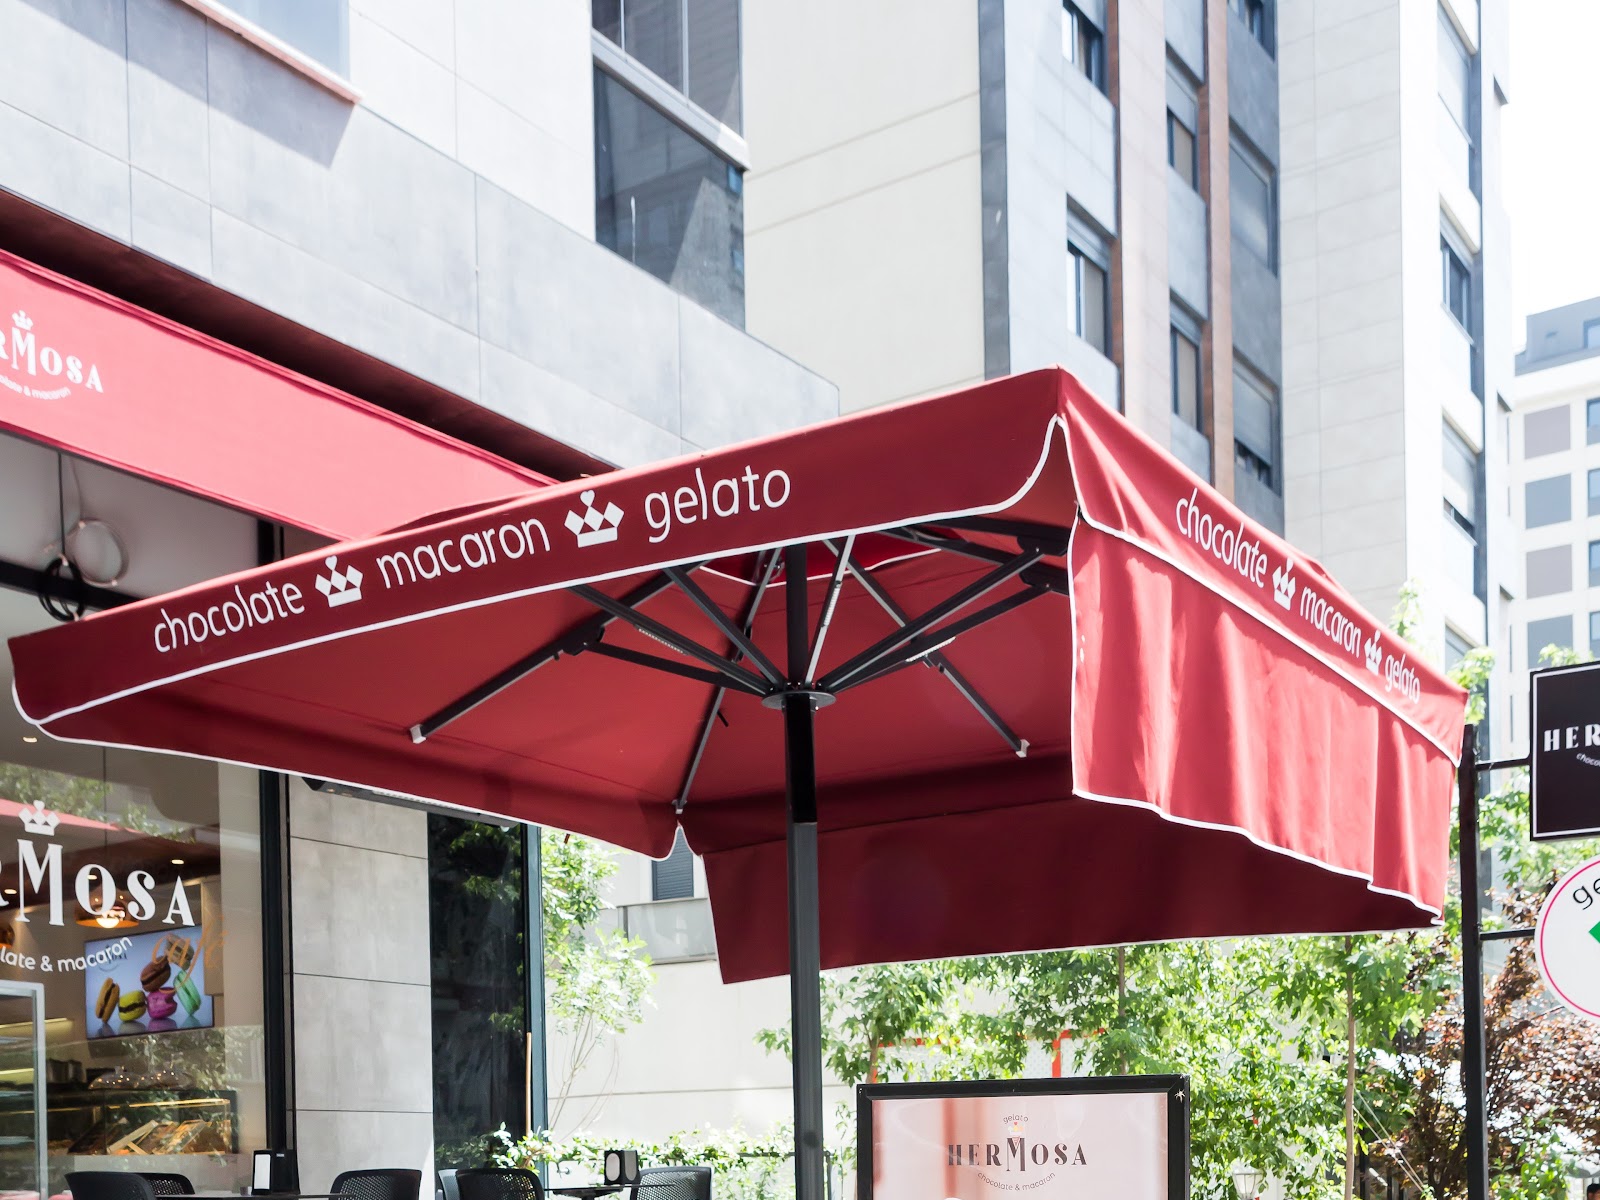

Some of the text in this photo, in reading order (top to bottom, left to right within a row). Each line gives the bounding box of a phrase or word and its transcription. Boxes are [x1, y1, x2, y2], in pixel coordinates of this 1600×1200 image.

[154, 465, 791, 653] chocolate macaron gelato
[1175, 487, 1421, 704] chocolate macaron gelato
[0, 838, 196, 927] MOSA
[40, 954, 54, 972] &
[57, 936, 133, 973] macaron
[1002, 1113, 1029, 1125] gelato
[947, 1136, 1088, 1172] HERMOSA
[977, 1171, 1056, 1191] chocolate & macaron
